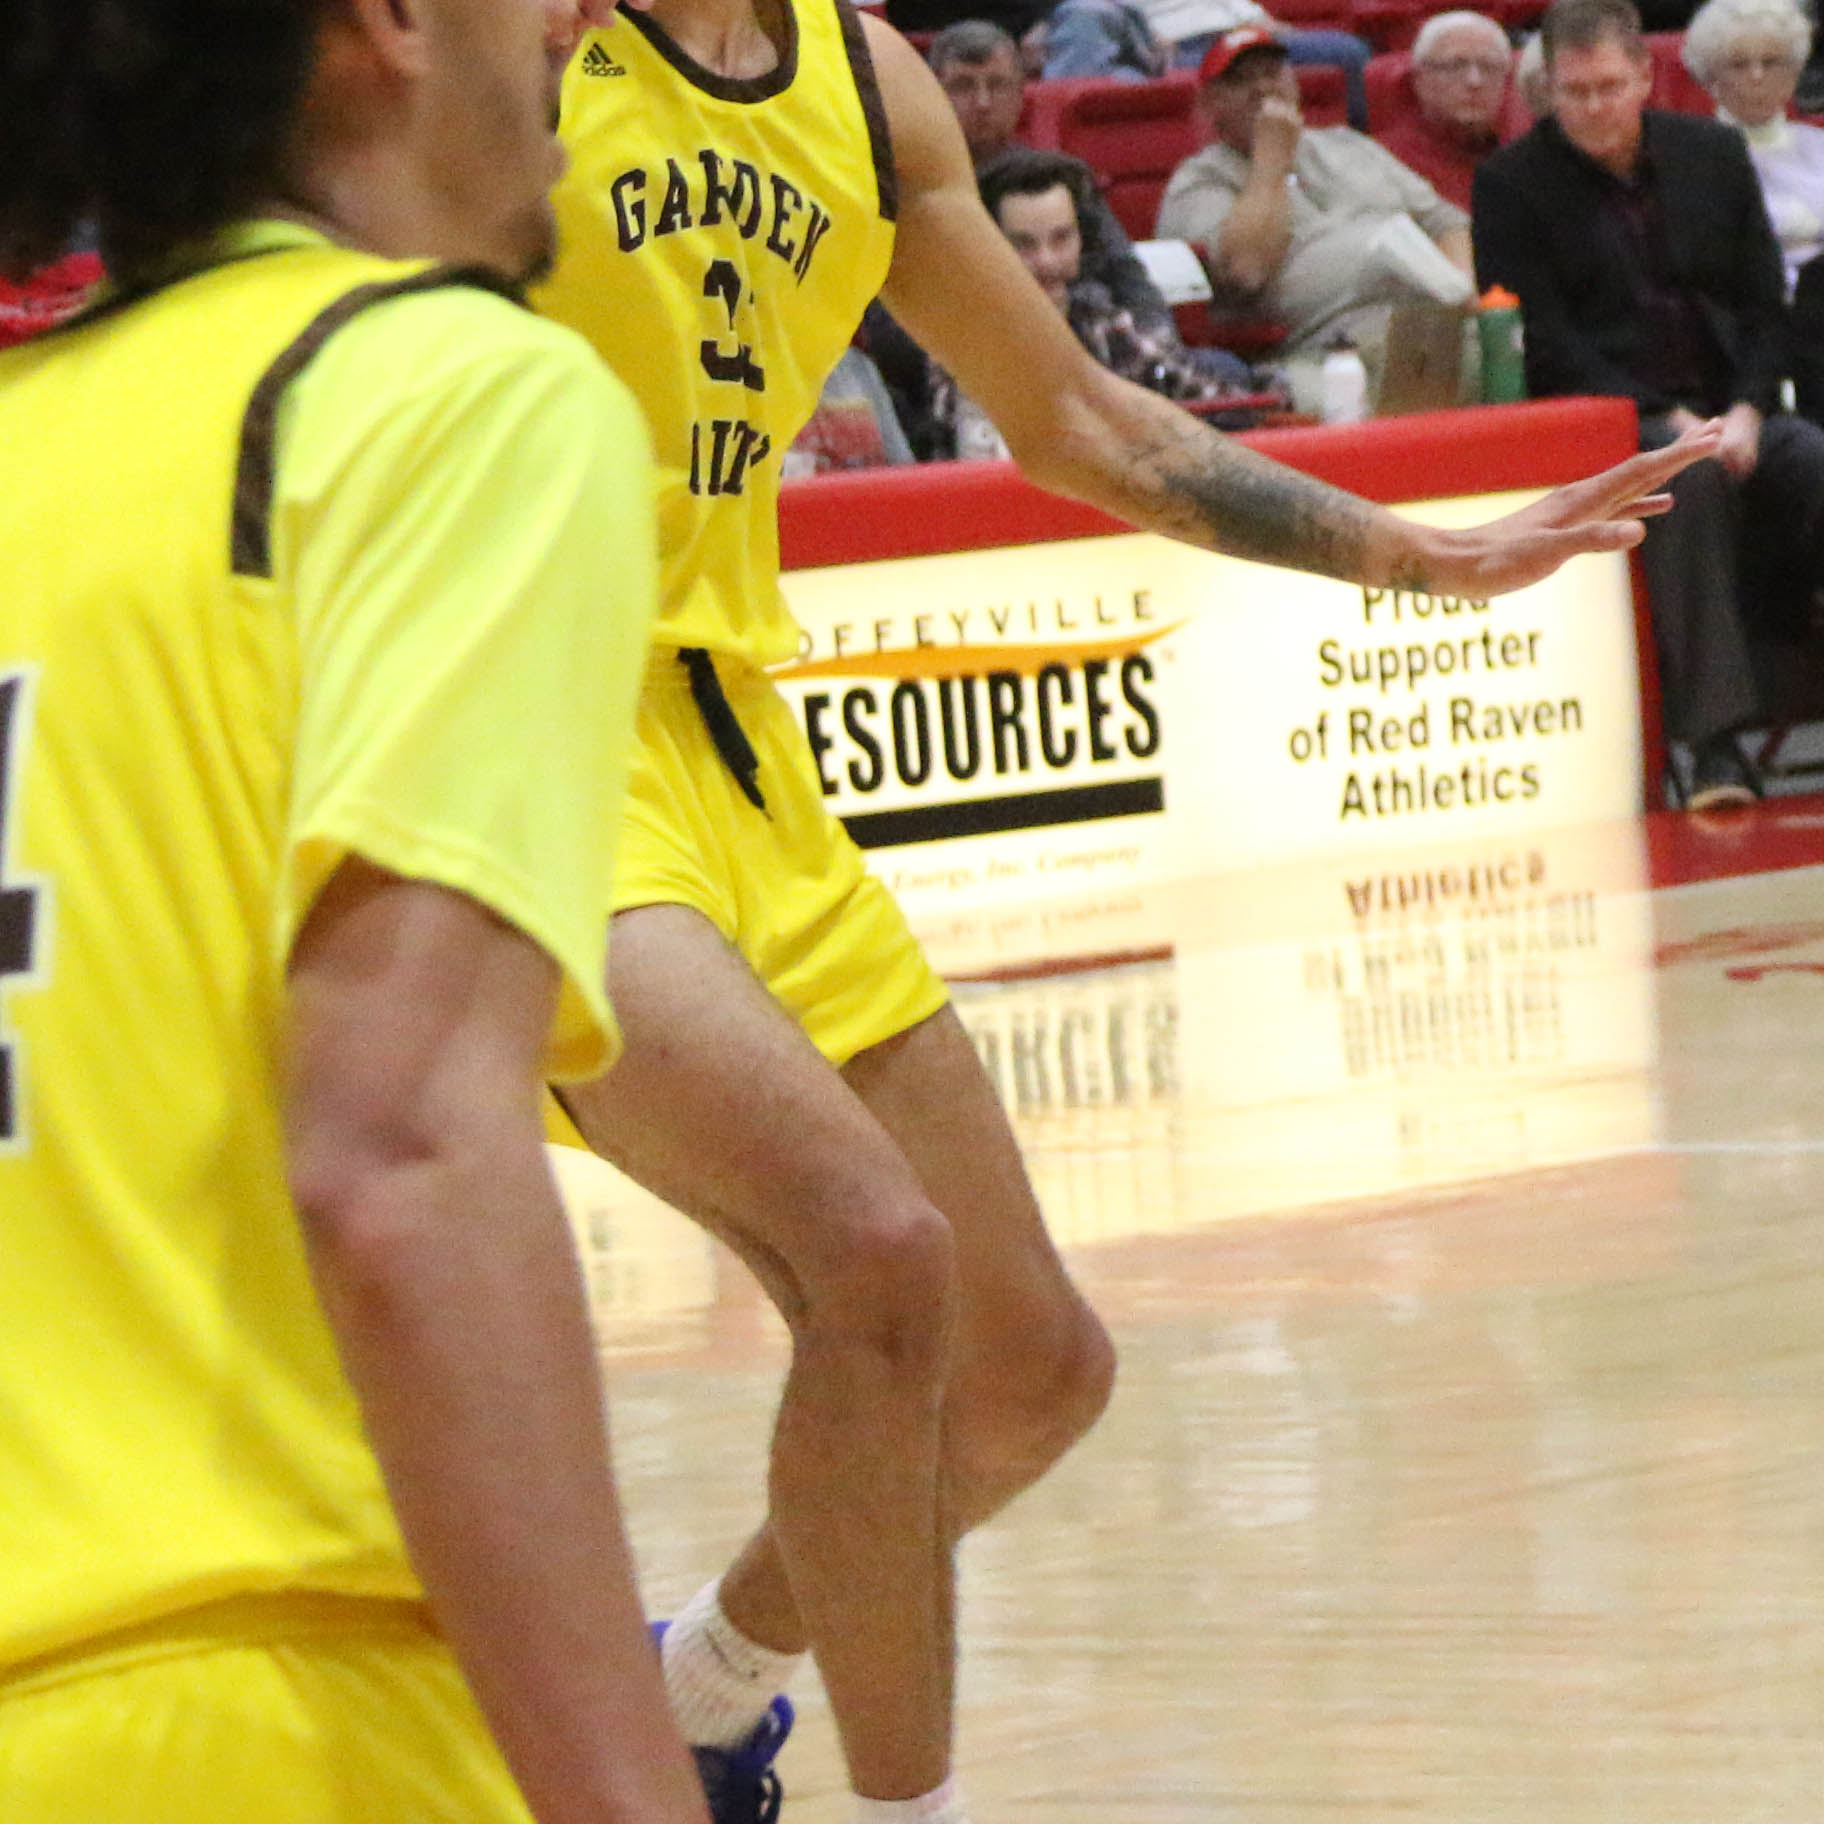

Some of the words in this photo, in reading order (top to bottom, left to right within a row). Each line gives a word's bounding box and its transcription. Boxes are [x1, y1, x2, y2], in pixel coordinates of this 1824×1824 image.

[1319, 628, 1540, 694] Supporter
[1289, 711, 1330, 761] of
[1349, 702, 1430, 754] Red
[1450, 696, 1582, 745] Raven
[1341, 756, 1540, 820] Athletics
